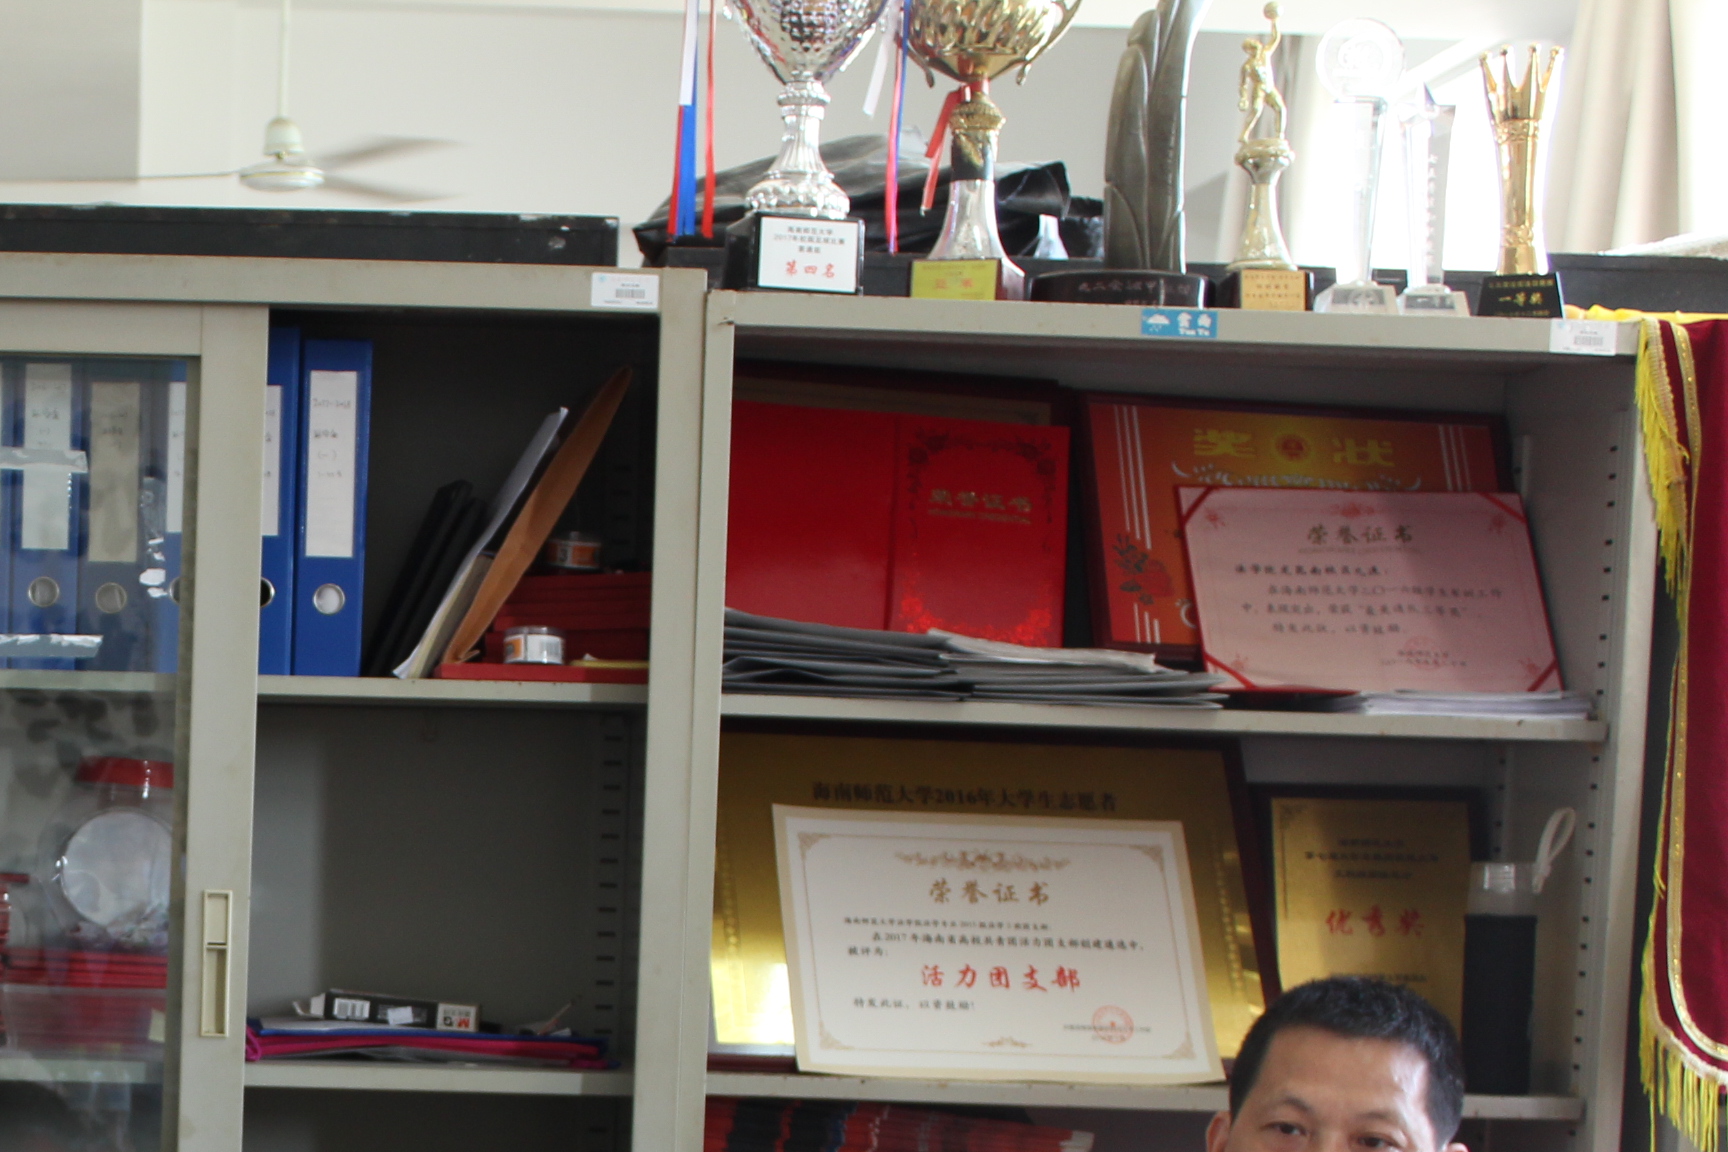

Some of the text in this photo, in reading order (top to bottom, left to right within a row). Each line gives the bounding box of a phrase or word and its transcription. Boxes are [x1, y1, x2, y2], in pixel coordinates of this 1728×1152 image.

[785, 259, 836, 278] 第四名
[1193, 428, 1396, 467] 奖状
[1307, 525, 1413, 544] 荣誉证书
[929, 878, 1051, 906] 荣誉证书
[1325, 904, 1425, 937] 优秀奖
[921, 963, 1081, 992] 活力团支部
